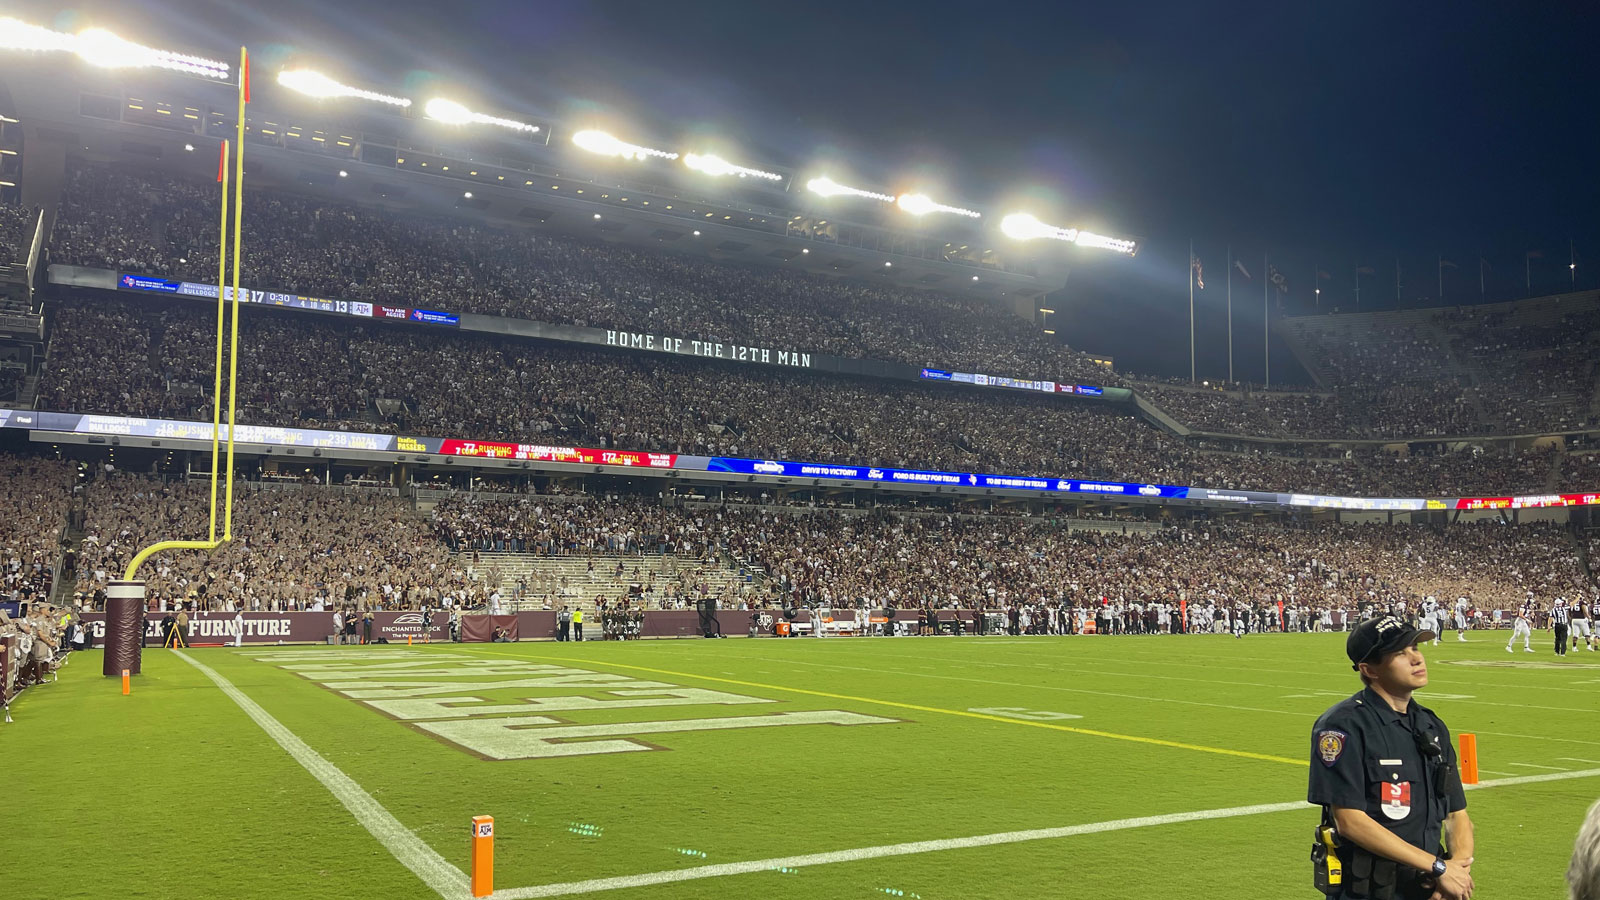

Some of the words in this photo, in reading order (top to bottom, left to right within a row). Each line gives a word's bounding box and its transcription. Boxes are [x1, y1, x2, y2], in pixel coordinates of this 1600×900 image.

[183, 289, 216, 297] BULLDOGS
[251, 291, 264, 303] 17
[269, 293, 290, 302] 0:30
[335, 301, 347, 312] 13
[607, 330, 654, 349] HOME
[663, 337, 682, 353] OF
[692, 340, 723, 357] THE
[731, 345, 770, 363] 12TH
[778, 351, 810, 368] MAN
[989, 377, 996, 385] 17
[1034, 381, 1041, 390] 13
[17, 416, 32, 424] Final
[89, 423, 130, 434] BULLDOGS
[479, 445, 512, 455] RUSHING
[801, 466, 821, 474] DRIVE
[821, 467, 829, 475] TO
[868, 469, 884, 479] Ford
[915, 473, 931, 481] BUILT
[930, 474, 943, 482] FOR
[942, 474, 960, 483] TEXAS
[1031, 480, 1048, 488] TEXAS
[188, 619, 291, 637] FURNTURE
